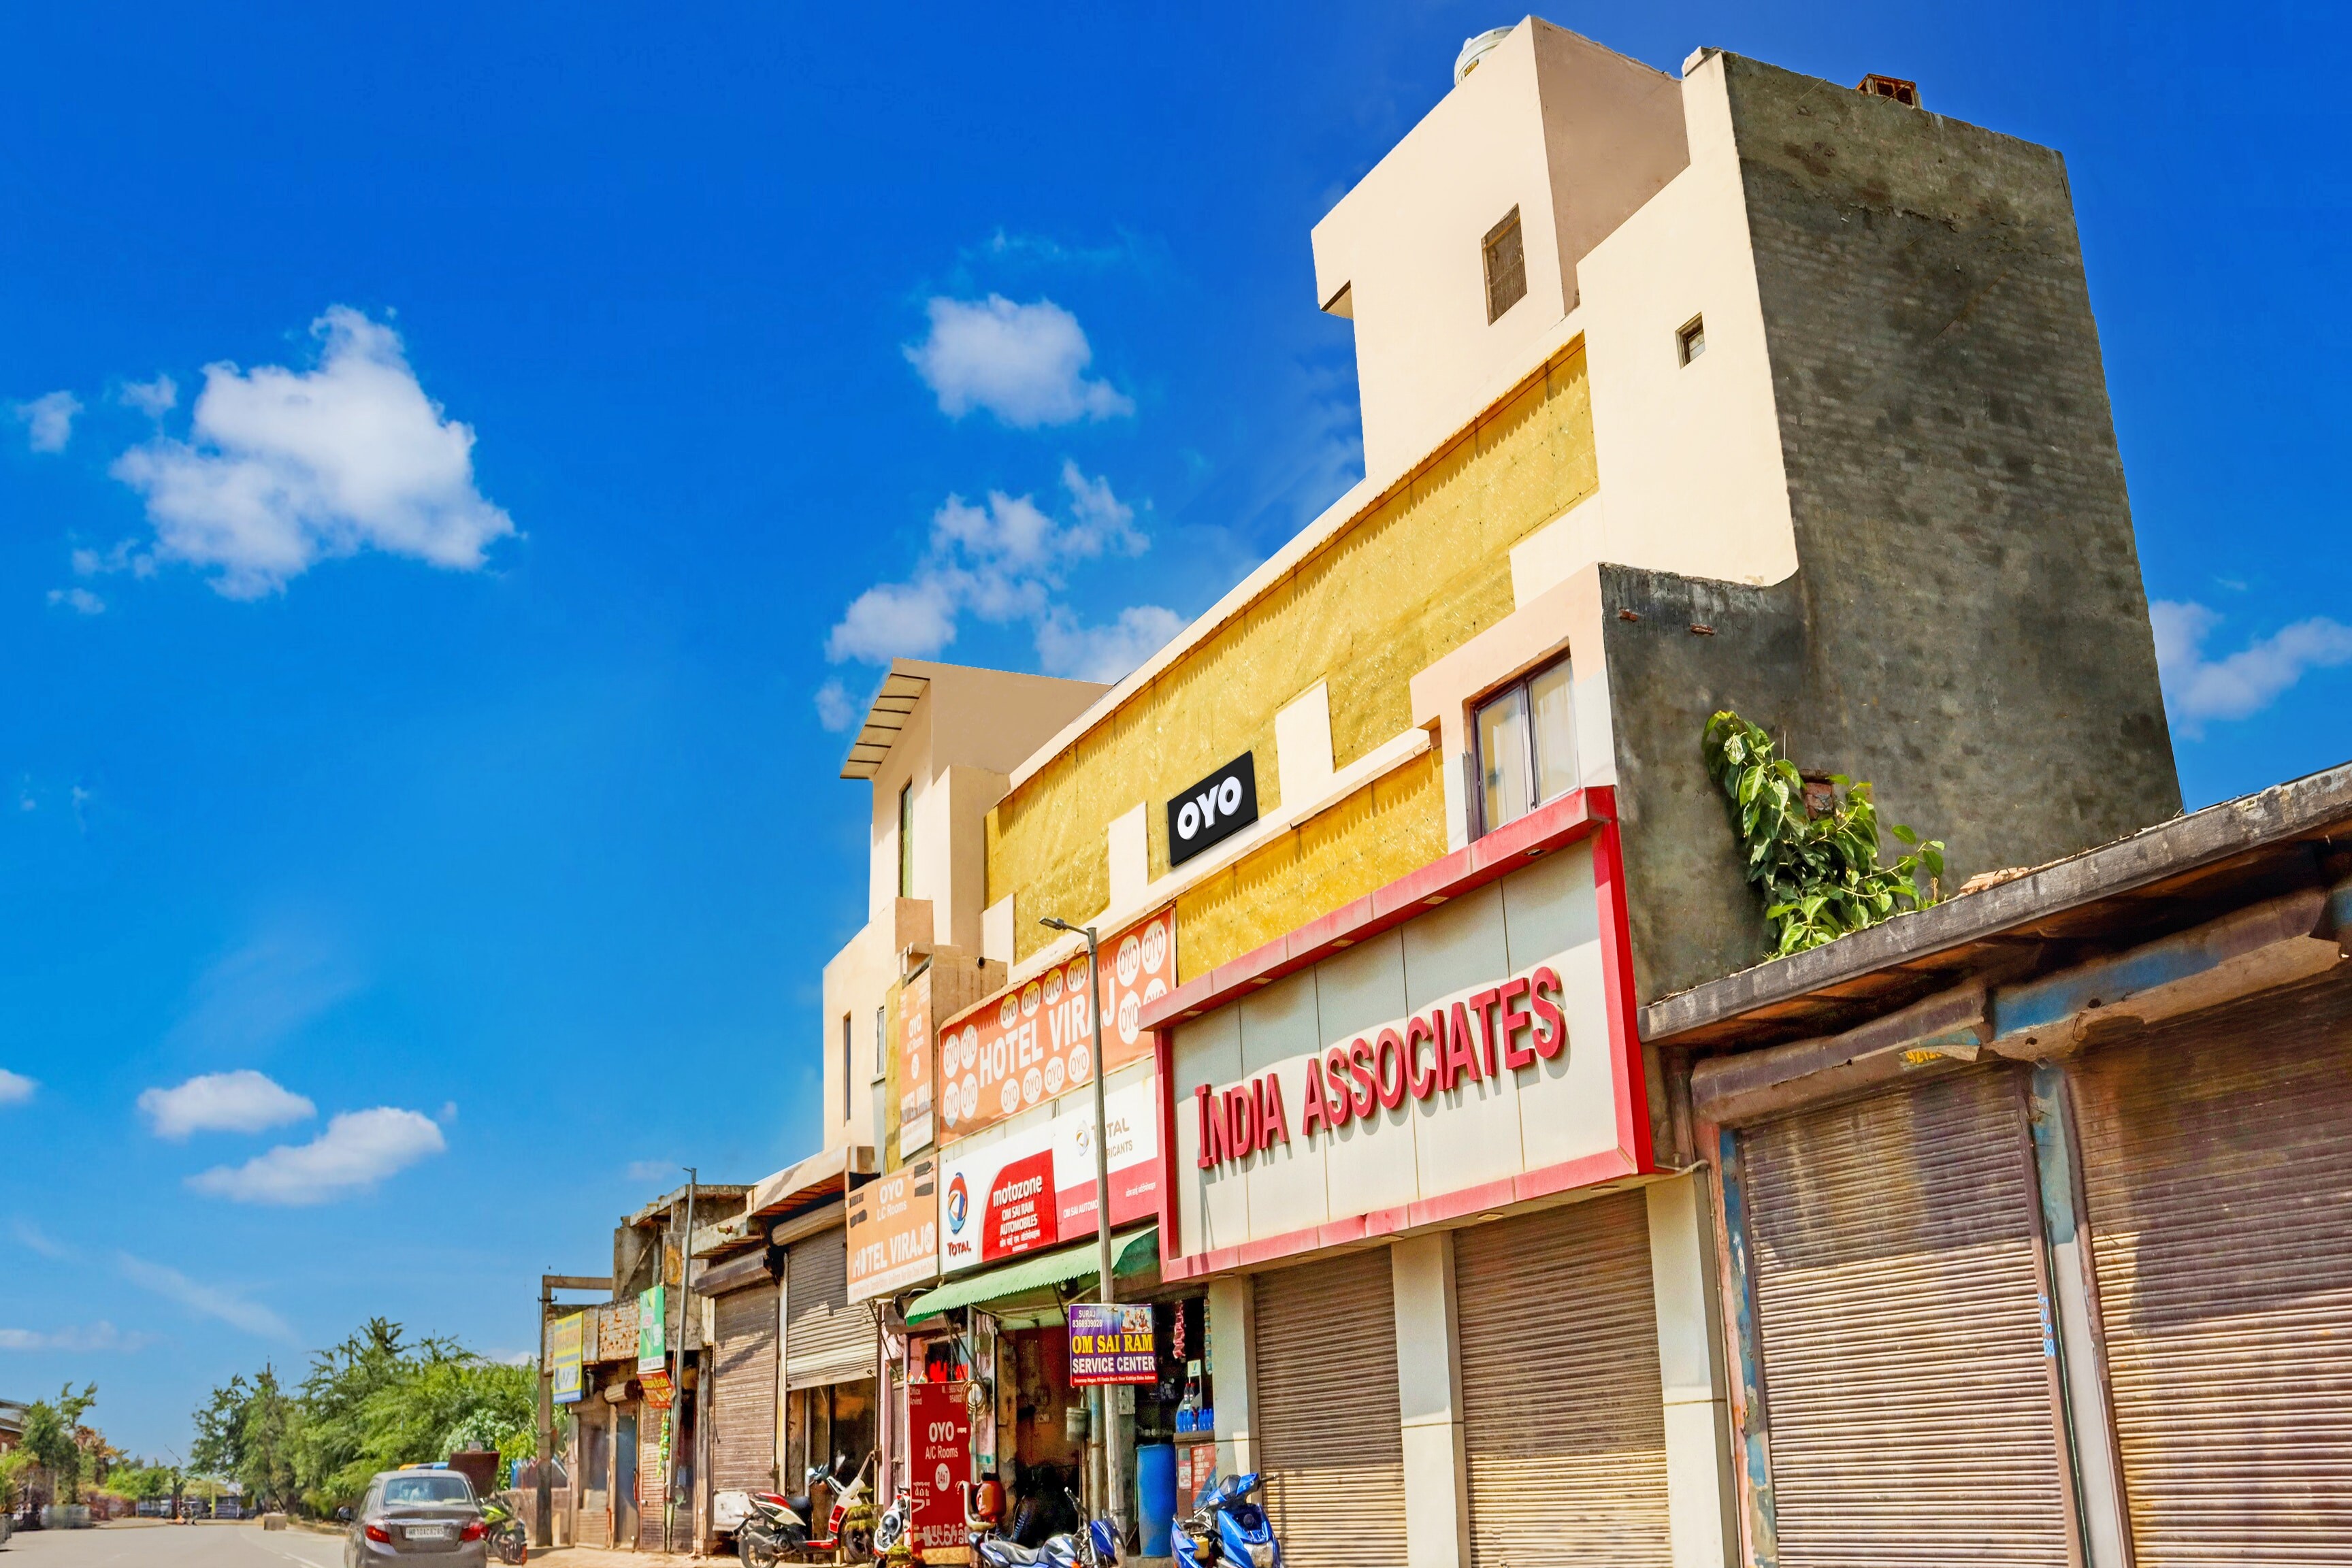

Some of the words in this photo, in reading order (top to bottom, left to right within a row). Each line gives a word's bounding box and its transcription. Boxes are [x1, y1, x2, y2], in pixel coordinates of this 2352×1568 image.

[1177, 776, 1243, 840] OYO
[1144, 931, 1163, 963] OYO
[1069, 961, 1086, 980] OYO
[1120, 945, 1138, 974] OYO
[1045, 975, 1062, 995] OYO
[1023, 989, 1040, 1009] OYO
[1002, 1000, 1017, 1021] OYO
[909, 1013, 921, 1038] OYO
[980, 1019, 1043, 1088] HOTEL
[1049, 977, 1115, 1051] VIRJ
[945, 1045, 958, 1067] OYO
[962, 1034, 975, 1058] OYO
[1071, 1052, 1087, 1075] OYO
[1194, 1073, 1289, 1169] INDIA
[1301, 966, 1566, 1137] ASSOCIATES
[1047, 1064, 1062, 1086] OYO
[962, 1083, 975, 1107] OYO
[1002, 1085, 1017, 1109] OYO
[1025, 1075, 1040, 1099] OYO
[945, 1094, 958, 1116] OYO
[1091, 1117, 1130, 1143] TTAL
[880, 1178, 904, 1204] OYO
[993, 1175, 1043, 1207] motozone
[887, 1200, 907, 1217] Rooms
[1002, 1207, 1011, 1222] OM
[1012, 1203, 1021, 1219] SAI
[1021, 1200, 1034, 1215] RAM
[1063, 1209, 1070, 1219] OM
[1079, 1199, 1098, 1214] AUTOMO
[1000, 1213, 1038, 1237] AUTOMOBILES
[853, 1241, 888, 1278] HOTEL
[889, 1225, 924, 1264] VIRAJ
[947, 1241, 971, 1257] TOTAL
[1079, 1309, 1096, 1318] SURAJ
[1072, 1335, 1094, 1354] OM
[1097, 1335, 1120, 1353] SAI
[1124, 1334, 1154, 1352] RAM
[1072, 1357, 1115, 1373] SERVICE
[1117, 1356, 1156, 1372] CENTER
[929, 1421, 954, 1443] OYO
[926, 1446, 936, 1460] A/C
[938, 1445, 958, 1458] Rooms
